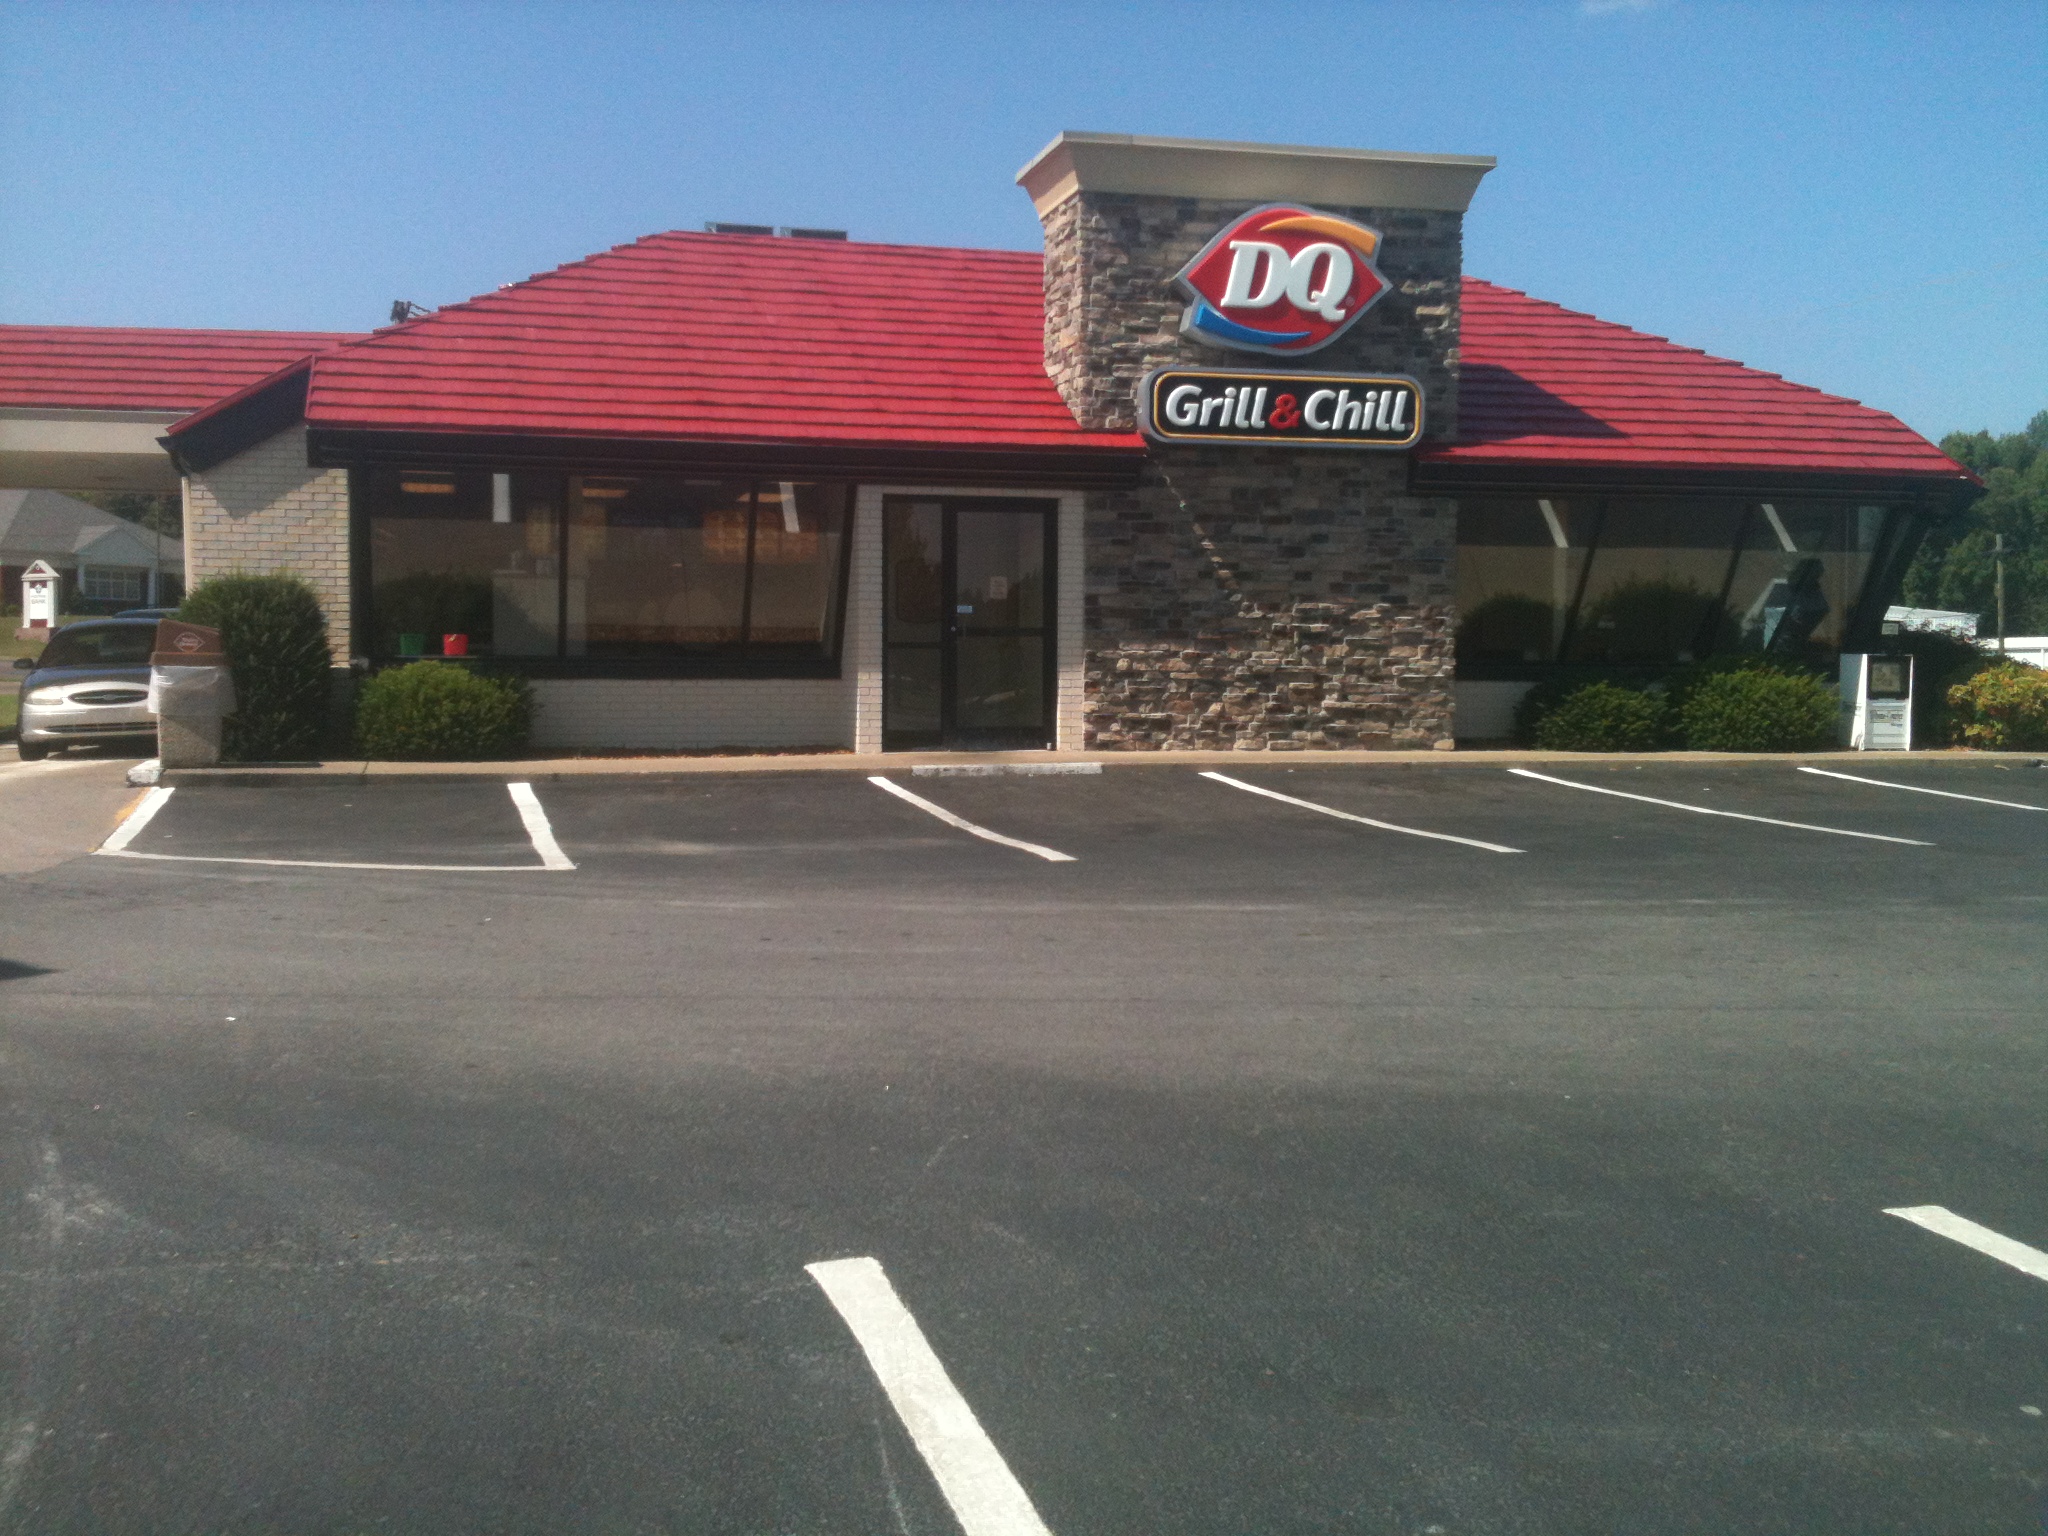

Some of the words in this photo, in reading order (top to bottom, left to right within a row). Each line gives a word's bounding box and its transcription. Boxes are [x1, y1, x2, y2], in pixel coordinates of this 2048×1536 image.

[1220, 240, 1354, 322] DQ
[1165, 384, 1268, 429] Grill
[1269, 393, 1301, 430] &
[1304, 389, 1408, 432] Chill
